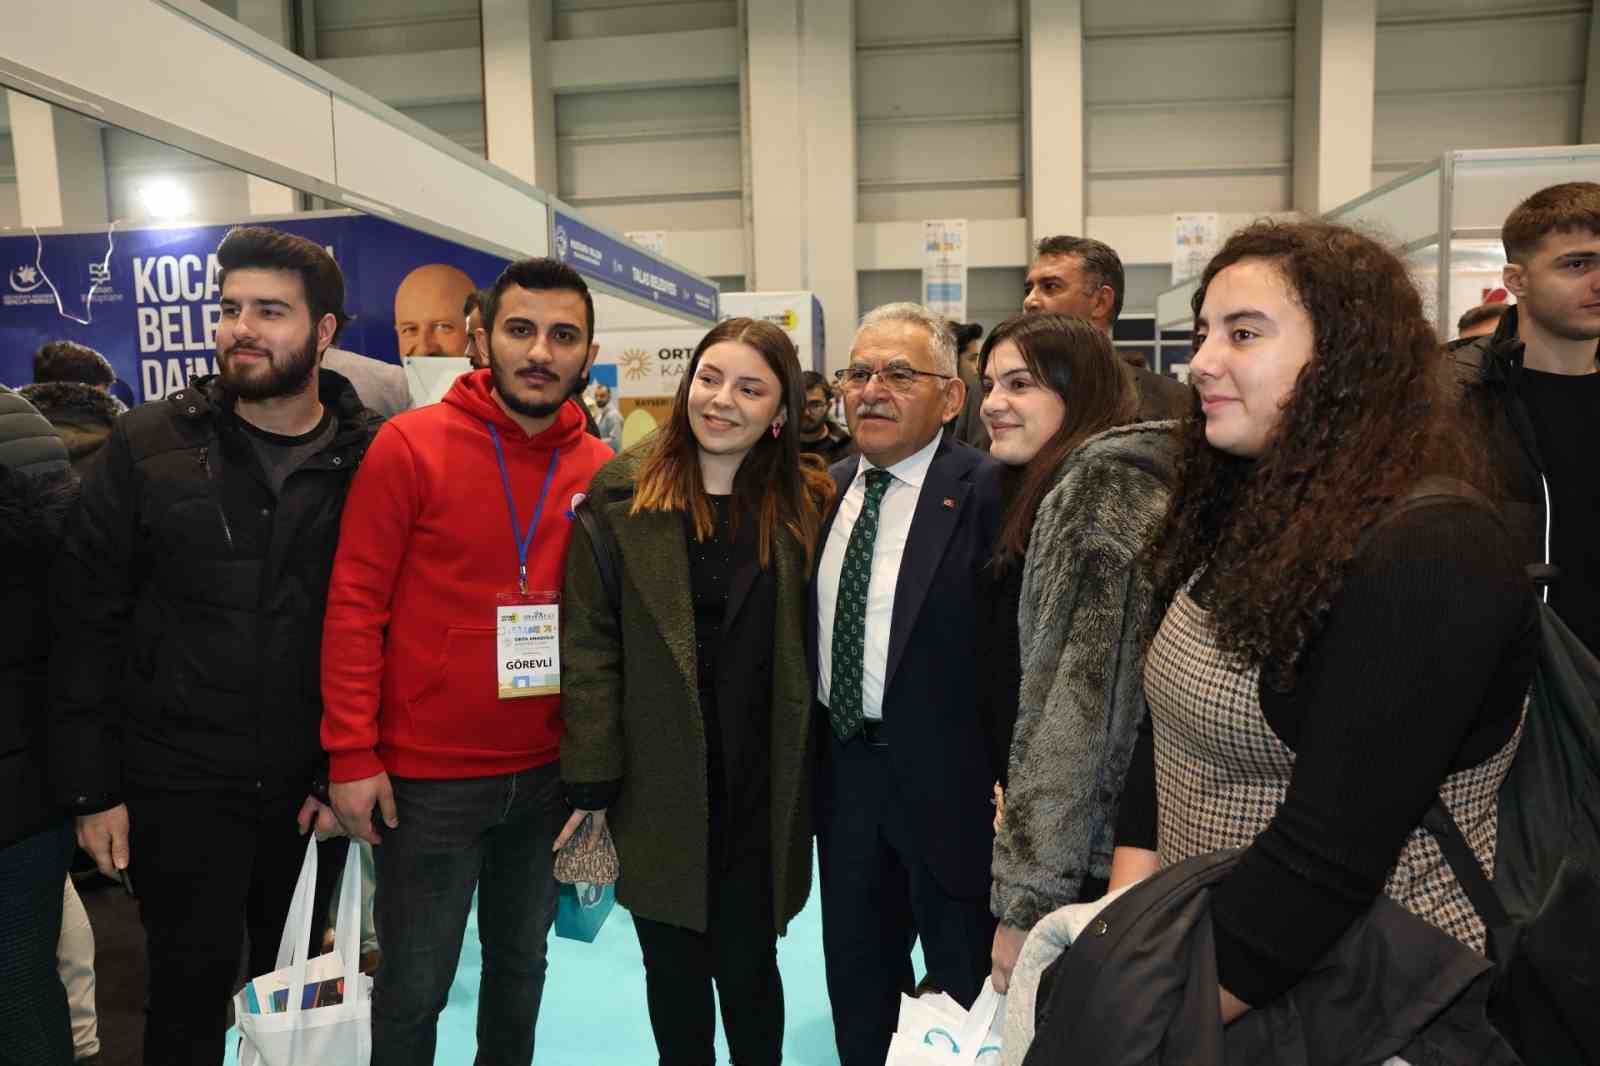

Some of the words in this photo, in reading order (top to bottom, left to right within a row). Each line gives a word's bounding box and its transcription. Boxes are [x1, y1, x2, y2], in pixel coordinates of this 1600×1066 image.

[133, 254, 222, 303] KOCA
[137, 304, 222, 353] BELE
[658, 347, 694, 361] ORT
[661, 364, 688, 377] KA
[506, 657, 552, 670] GÖREVLİ
